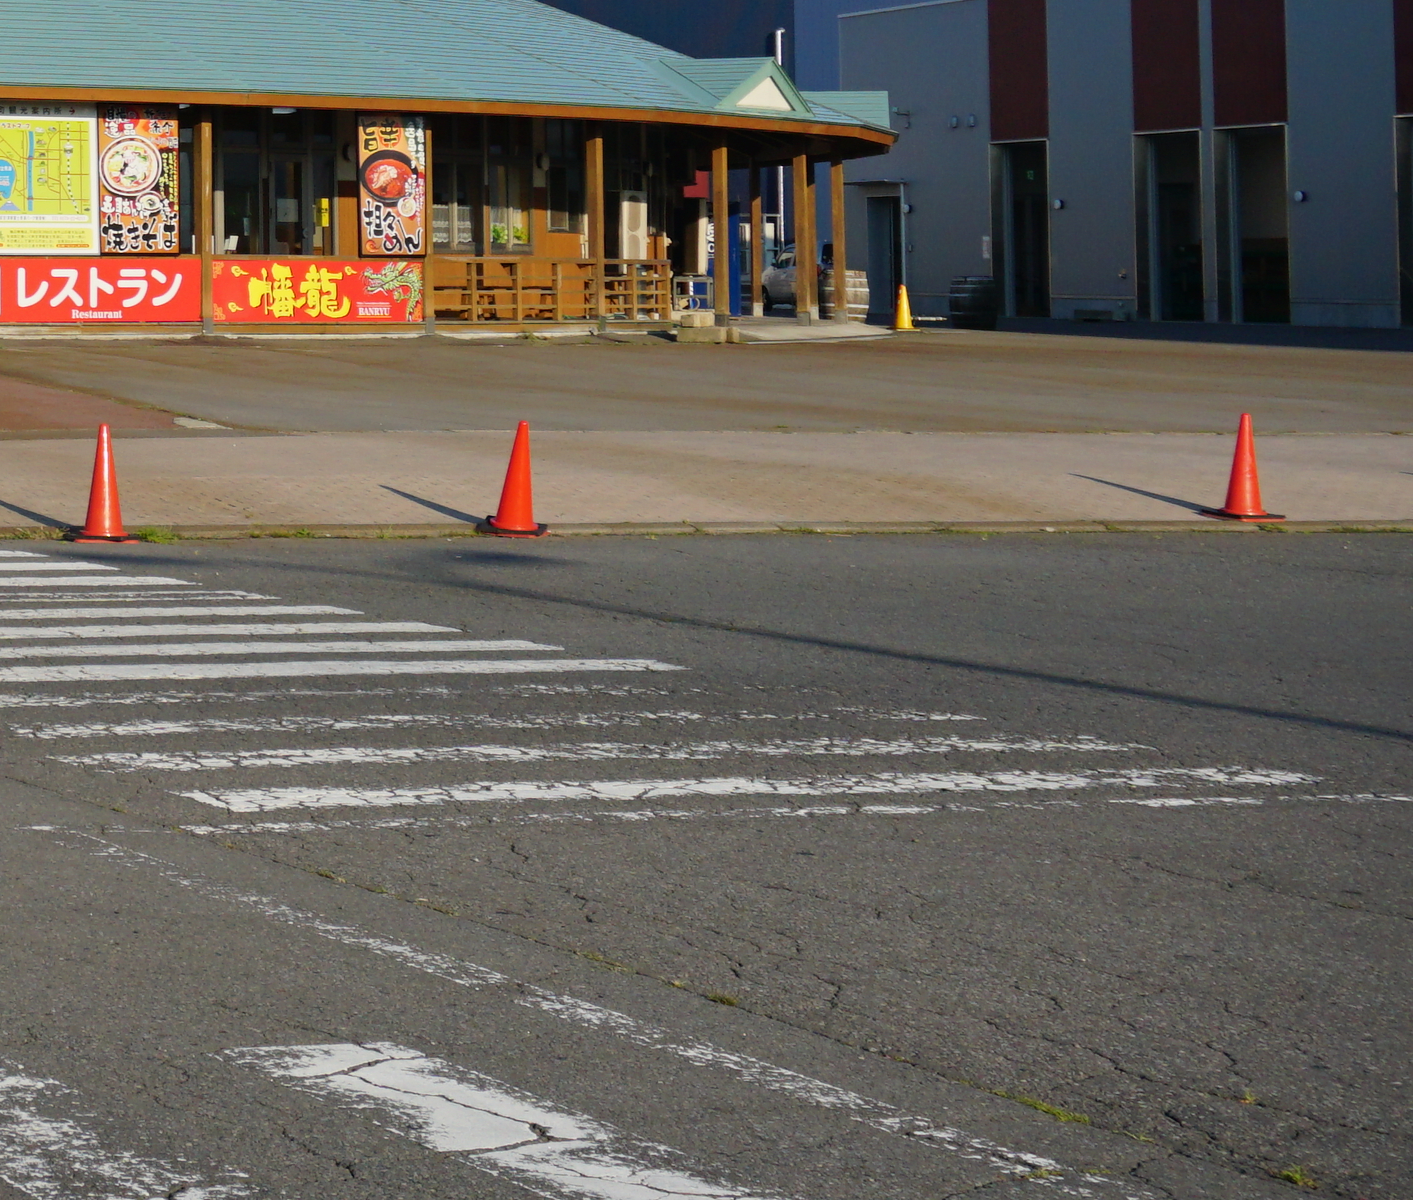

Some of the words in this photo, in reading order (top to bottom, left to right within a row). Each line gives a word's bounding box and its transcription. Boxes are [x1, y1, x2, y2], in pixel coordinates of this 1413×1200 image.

[102, 213, 177, 251] 焼きそば
[16, 266, 184, 309] レストラン
[71, 308, 123, 319] Restaurant
[358, 307, 390, 316] BANRYU
